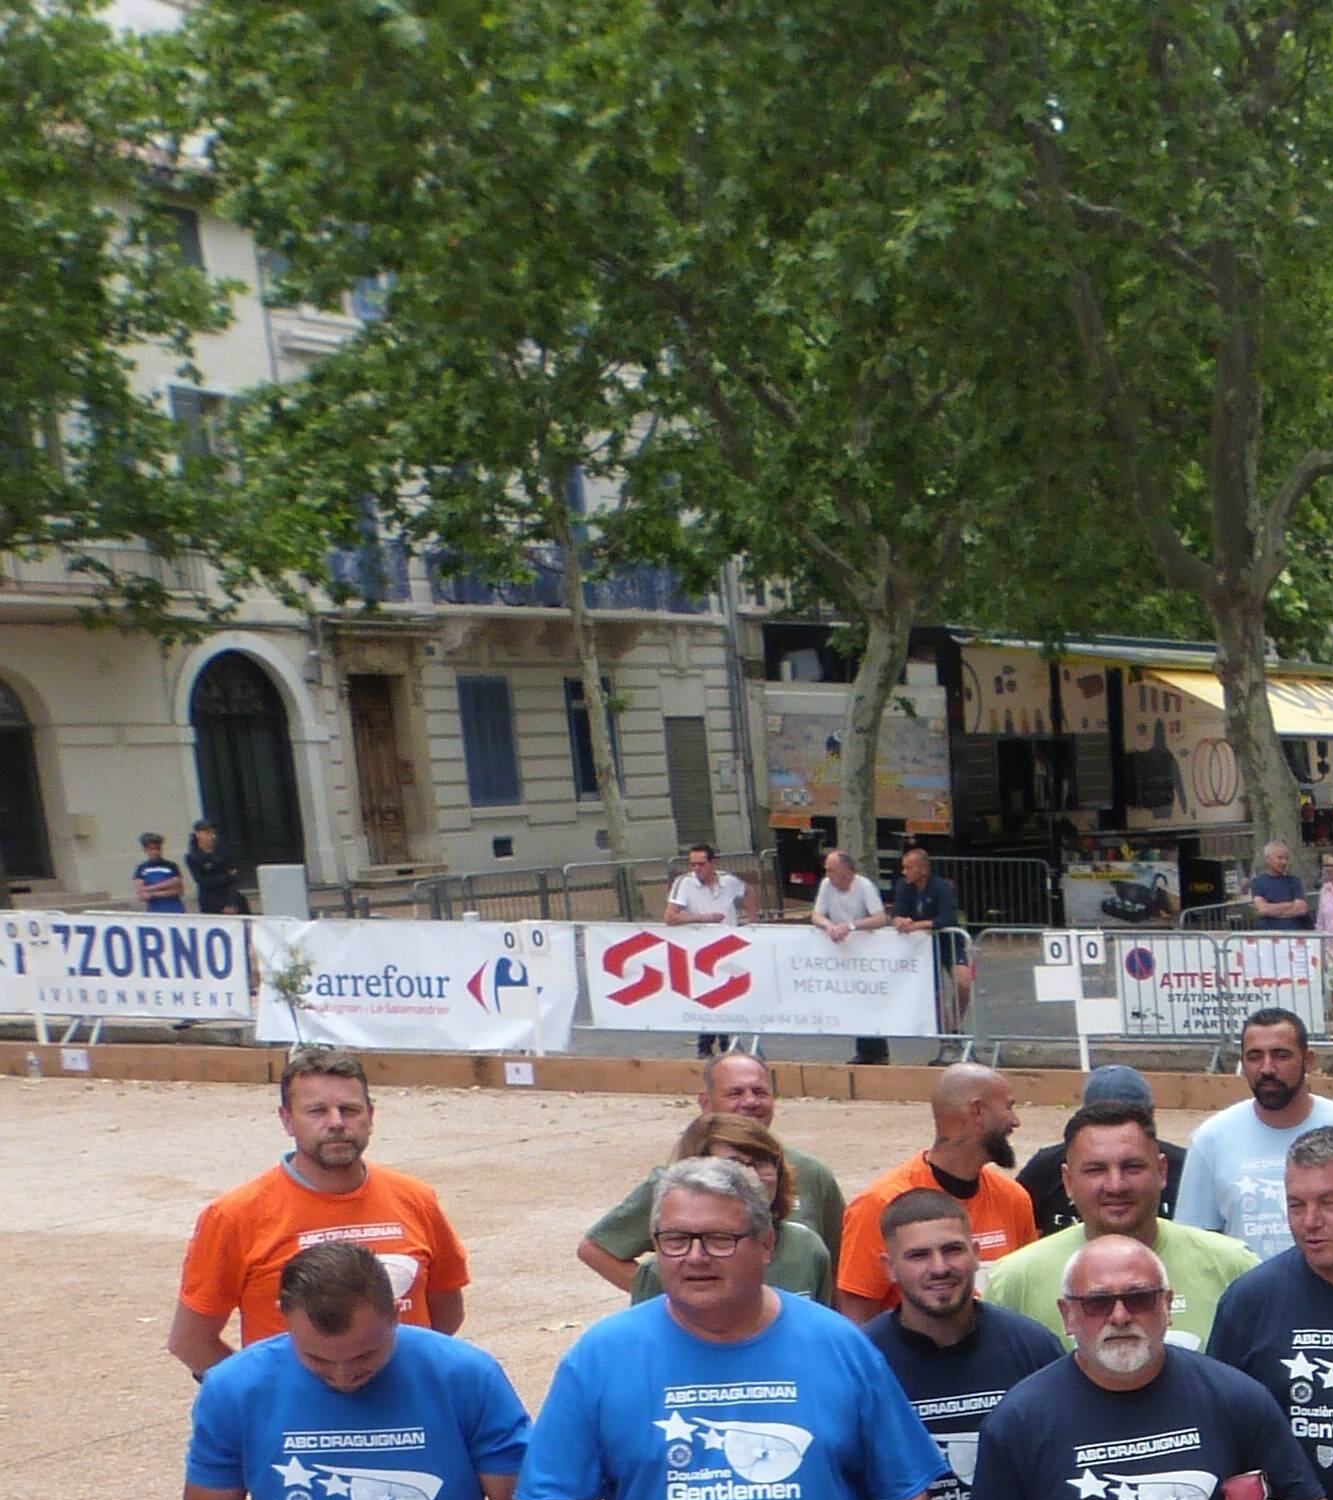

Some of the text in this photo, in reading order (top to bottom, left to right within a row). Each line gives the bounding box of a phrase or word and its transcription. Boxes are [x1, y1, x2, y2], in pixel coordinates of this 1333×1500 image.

[504, 929, 544, 949] 0 0
[1051, 942, 1099, 960] 0 0
[790, 957, 920, 974] L'ARCHITECTURE
[793, 976, 889, 996] MÉTALLIQUE
[1292, 1334, 1321, 1345] ABC
[665, 1385, 798, 1405] ABC DRAGUIGNAN
[284, 1431, 426, 1449] ABC DRAGUIGNAN
[1076, 1432, 1201, 1463] ABC DRAGUIGNAN
